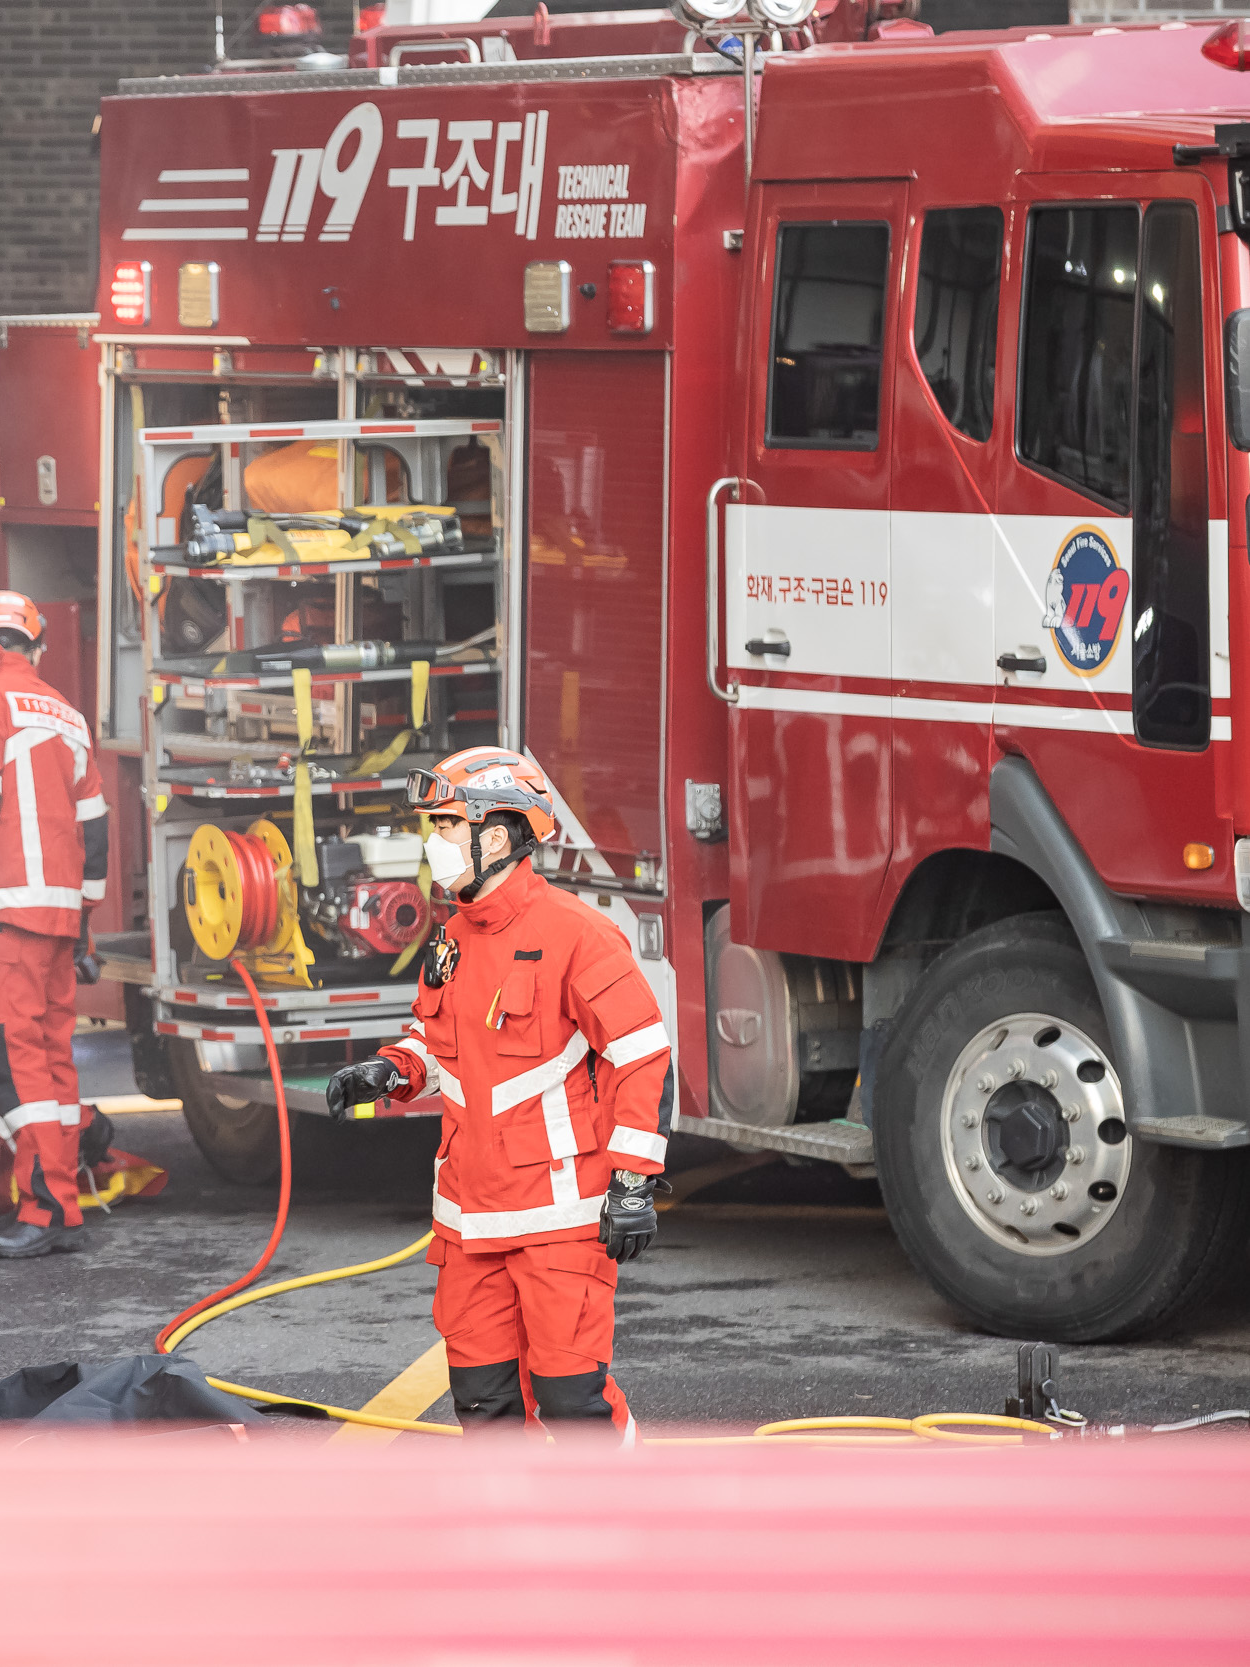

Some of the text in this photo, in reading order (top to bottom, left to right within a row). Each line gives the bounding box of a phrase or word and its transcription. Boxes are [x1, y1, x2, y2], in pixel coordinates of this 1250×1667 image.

[255, 101, 549, 243] 119 구조대
[557, 164, 630, 200] TECHNICAL
[554, 203, 647, 239] RESCUE TEAM
[1060, 540, 1077, 568] Seoul
[1075, 536, 1089, 550] Fire
[860, 579, 888, 607] 119
[1061, 567, 1130, 641] 119
